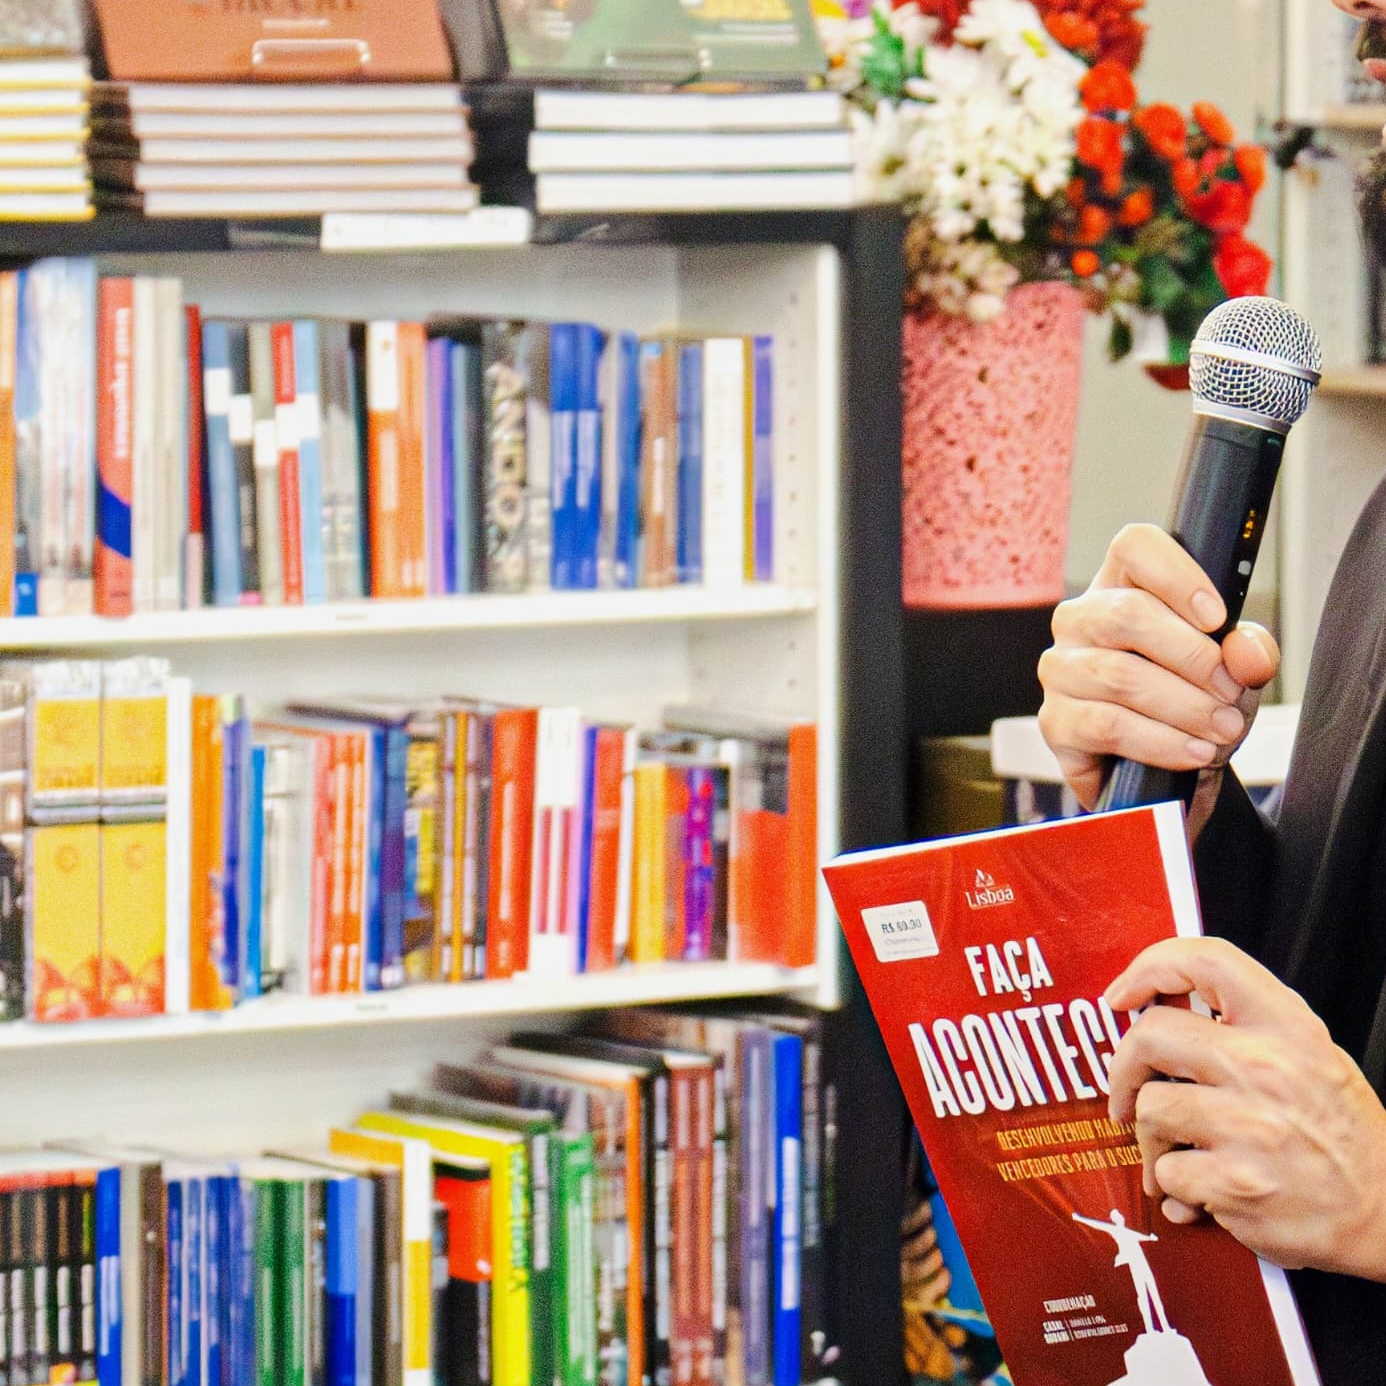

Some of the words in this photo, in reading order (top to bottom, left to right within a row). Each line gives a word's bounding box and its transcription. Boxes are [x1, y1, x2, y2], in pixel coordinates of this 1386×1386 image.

[965, 885, 1015, 910] Lisboa
[964, 936, 1054, 1003] FAÇA
[907, 995, 1140, 1119] ACONTEC
[996, 1120, 1095, 1151] DESENVOLVENDO
[996, 1154, 1074, 1182] VENCEDORES
[1072, 1149, 1107, 1172] PARA
[1105, 1148, 1118, 1167] O
[1115, 1145, 1143, 1166] SUC
